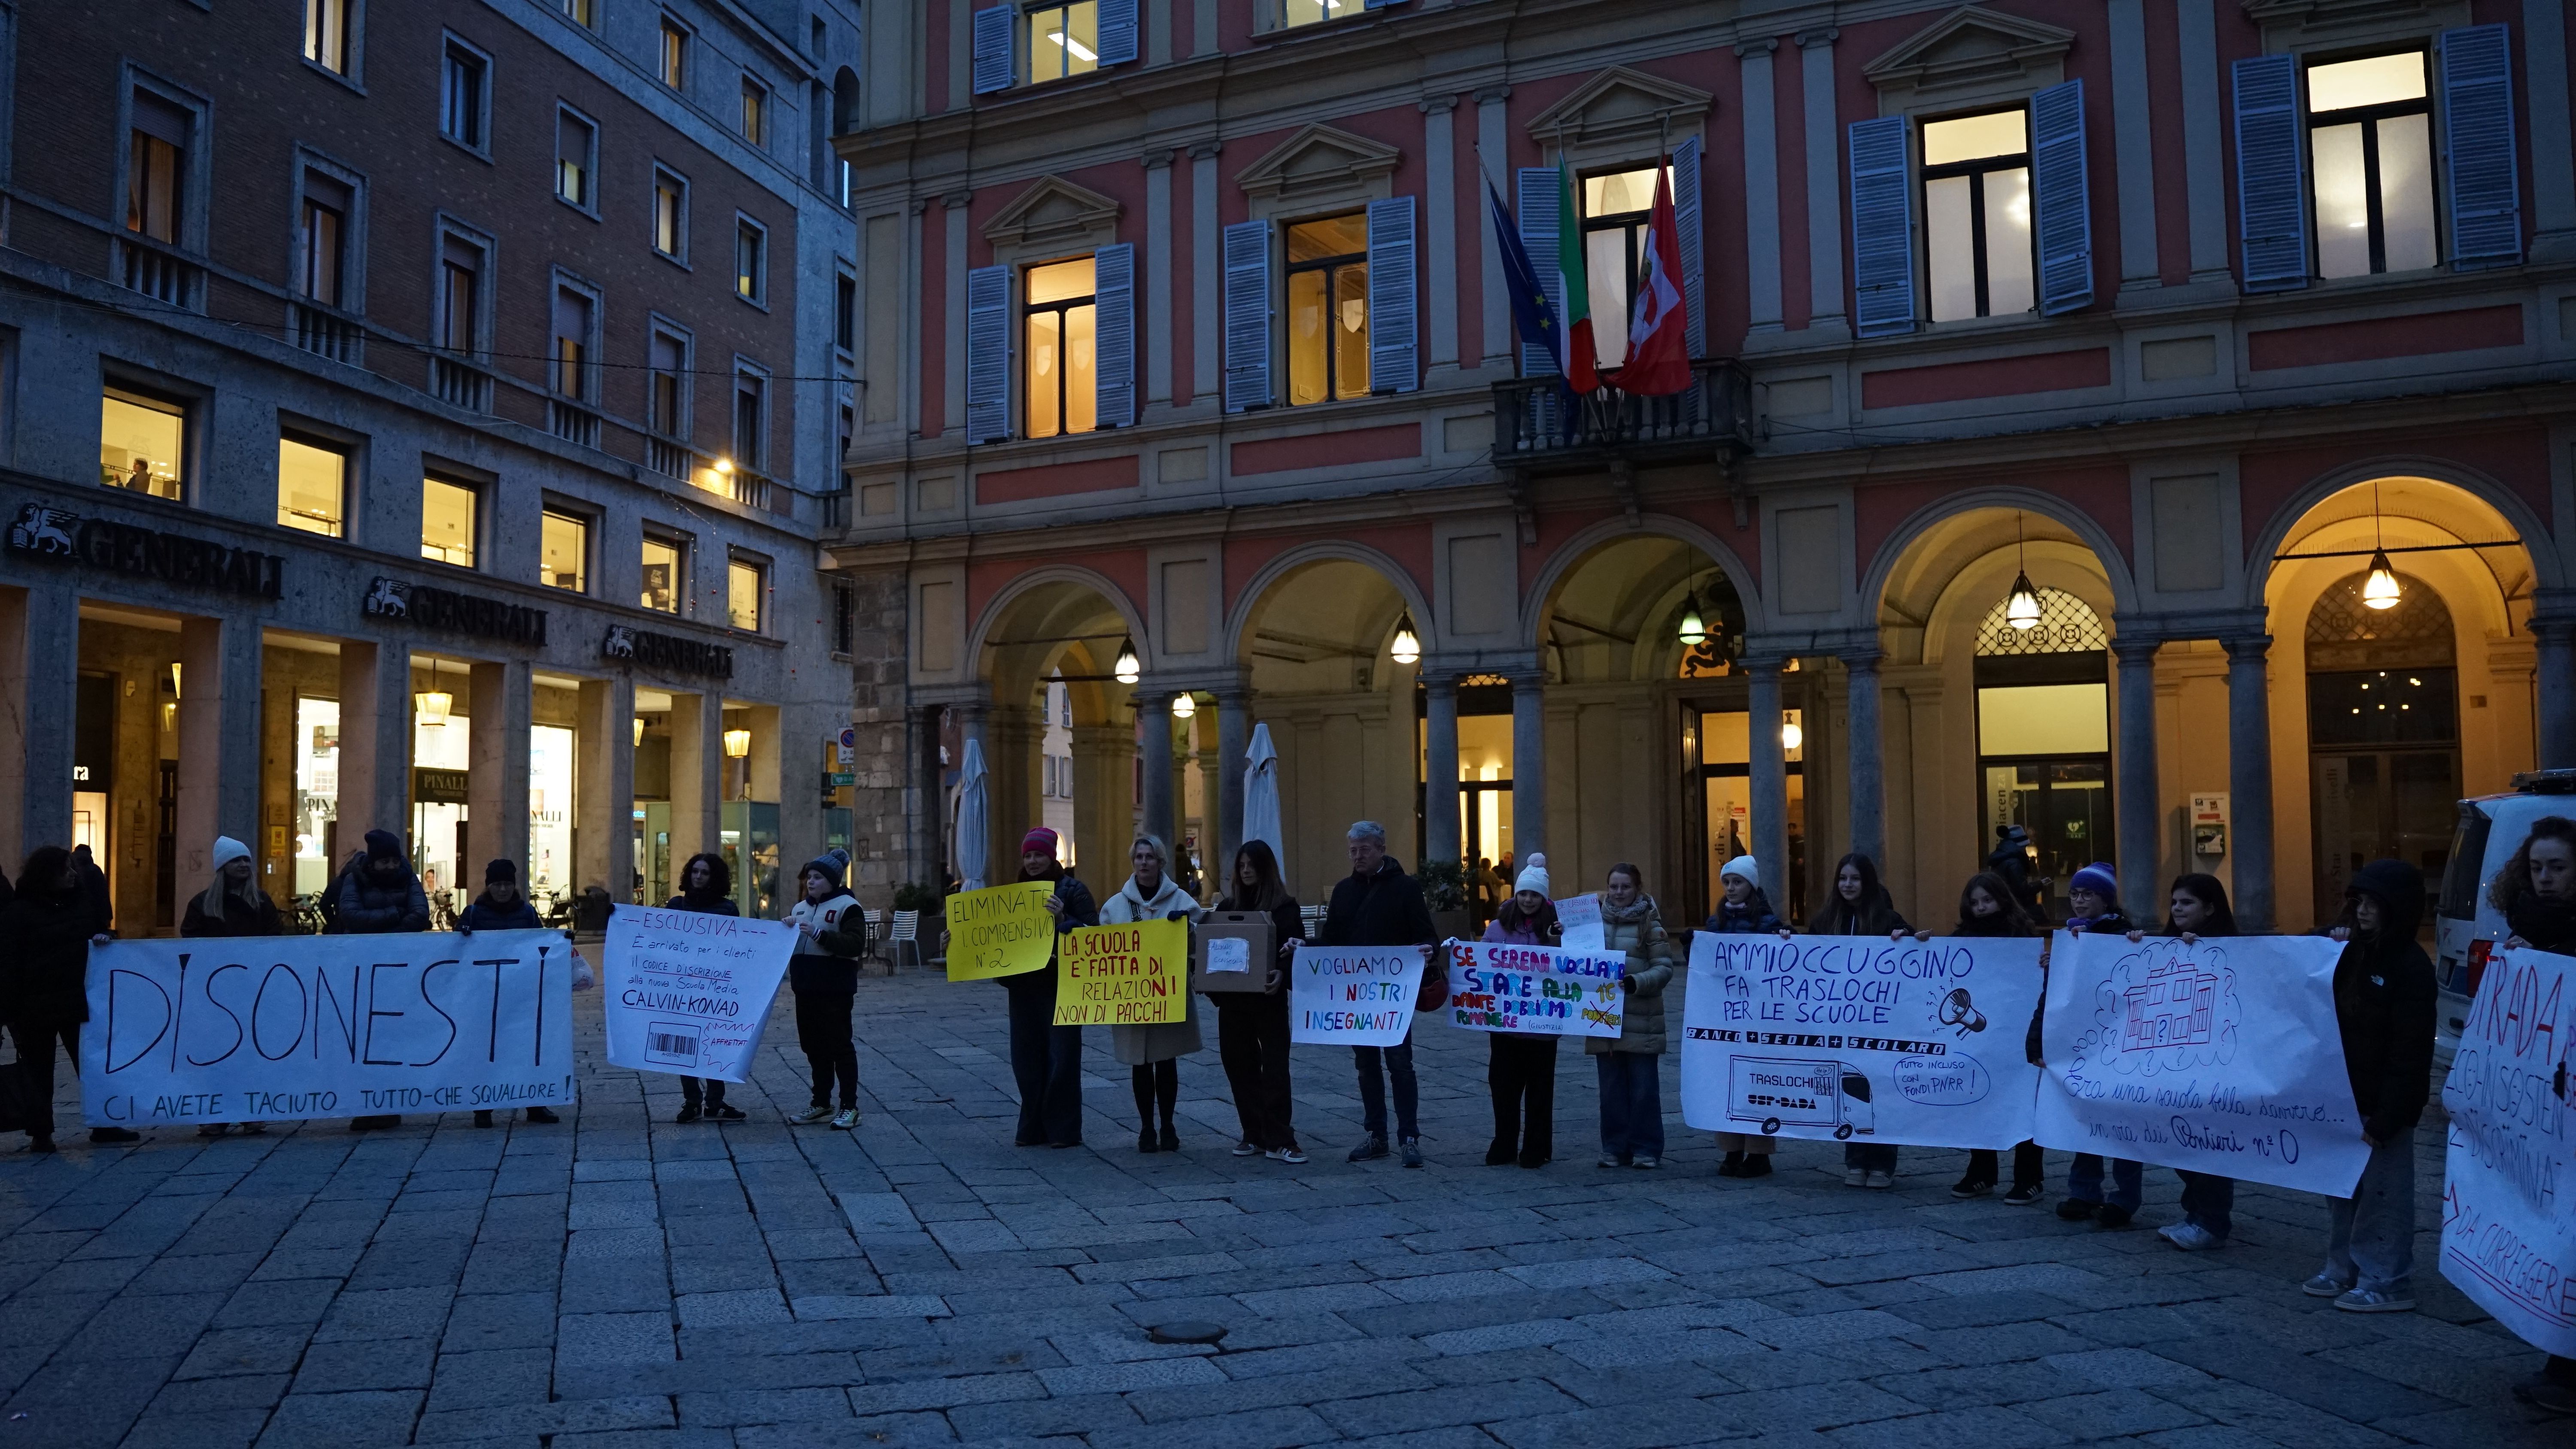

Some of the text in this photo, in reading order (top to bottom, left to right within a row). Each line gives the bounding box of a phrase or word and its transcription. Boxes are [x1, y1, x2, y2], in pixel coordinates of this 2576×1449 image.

[80, 518, 285, 600] GENERALI
[409, 585, 547, 646] GENERALI
[635, 631, 733, 679] GENERALI
[1996, 774, 2006, 826] iacenza
[954, 888, 1053, 923] ELIMINATE
[972, 915, 1055, 946] COMRENSIVO
[1064, 930, 1140, 957] LA SCUOLA
[632, 955, 638, 968] il
[643, 960, 668, 971] CODICE
[648, 940, 689, 953] arrivato
[697, 947, 712, 956] per
[724, 947, 757, 959] clienti
[989, 948, 1012, 969] 2
[1453, 945, 1625, 981] SE SERENI VOGLIAMO
[1715, 941, 1974, 979] AMMIOCCUGGINO
[1090, 955, 1139, 977] FATTA
[1149, 956, 1163, 976] DI
[1308, 956, 1403, 976] VOGLIAMO
[628, 976, 739, 995] alla nuova Scuola Media
[1082, 975, 1176, 1001] RELAZIONI
[1330, 982, 1407, 1002] I NOSTRI
[1464, 968, 1532, 997] STARE
[1542, 977, 1583, 1003] ALLA
[1725, 975, 1901, 1004] FA TRASLOCHI
[106, 946, 550, 1074] DISONESTI
[622, 989, 739, 1017] CALVIN-KONAD
[1055, 1000, 1167, 1025] NON DI PACCHI
[1452, 992, 1495, 1012] DANTE
[1504, 999, 1573, 1019] DOBBIAMO
[1724, 1000, 1891, 1024] PER LE SCUOLE
[1306, 1010, 1403, 1031] INSEGNANTI
[1456, 1009, 1518, 1028] RIMANERE
[1686, 1027, 1741, 1042] BANCO
[1761, 1033, 1825, 1047] SEDIA
[1848, 1036, 1946, 1055] SCOLARO
[1900, 1060, 1965, 1070] TUTTO INCLUSO
[1902, 1074, 1919, 1083] CON
[1749, 1073, 1813, 1088] TRASLOCHI
[1905, 1083, 1931, 1095] FONDI
[104, 1095, 135, 1121] CI
[152, 1093, 223, 1118] AVETE
[244, 1089, 337, 1116] TACIUTO
[361, 1085, 462, 1109] TUTTO-CHE
[1748, 1094, 1817, 1109] USP-DADA
[2112, 1082, 2149, 1103] una
[2155, 1079, 2203, 1109] scuola
[2207, 1083, 2251, 1116] bella
[2089, 1116, 2109, 1138] in
[2112, 1122, 2138, 1143] via
[2144, 1120, 2168, 1144] dei
[2457, 1205, 2481, 1247] DA
